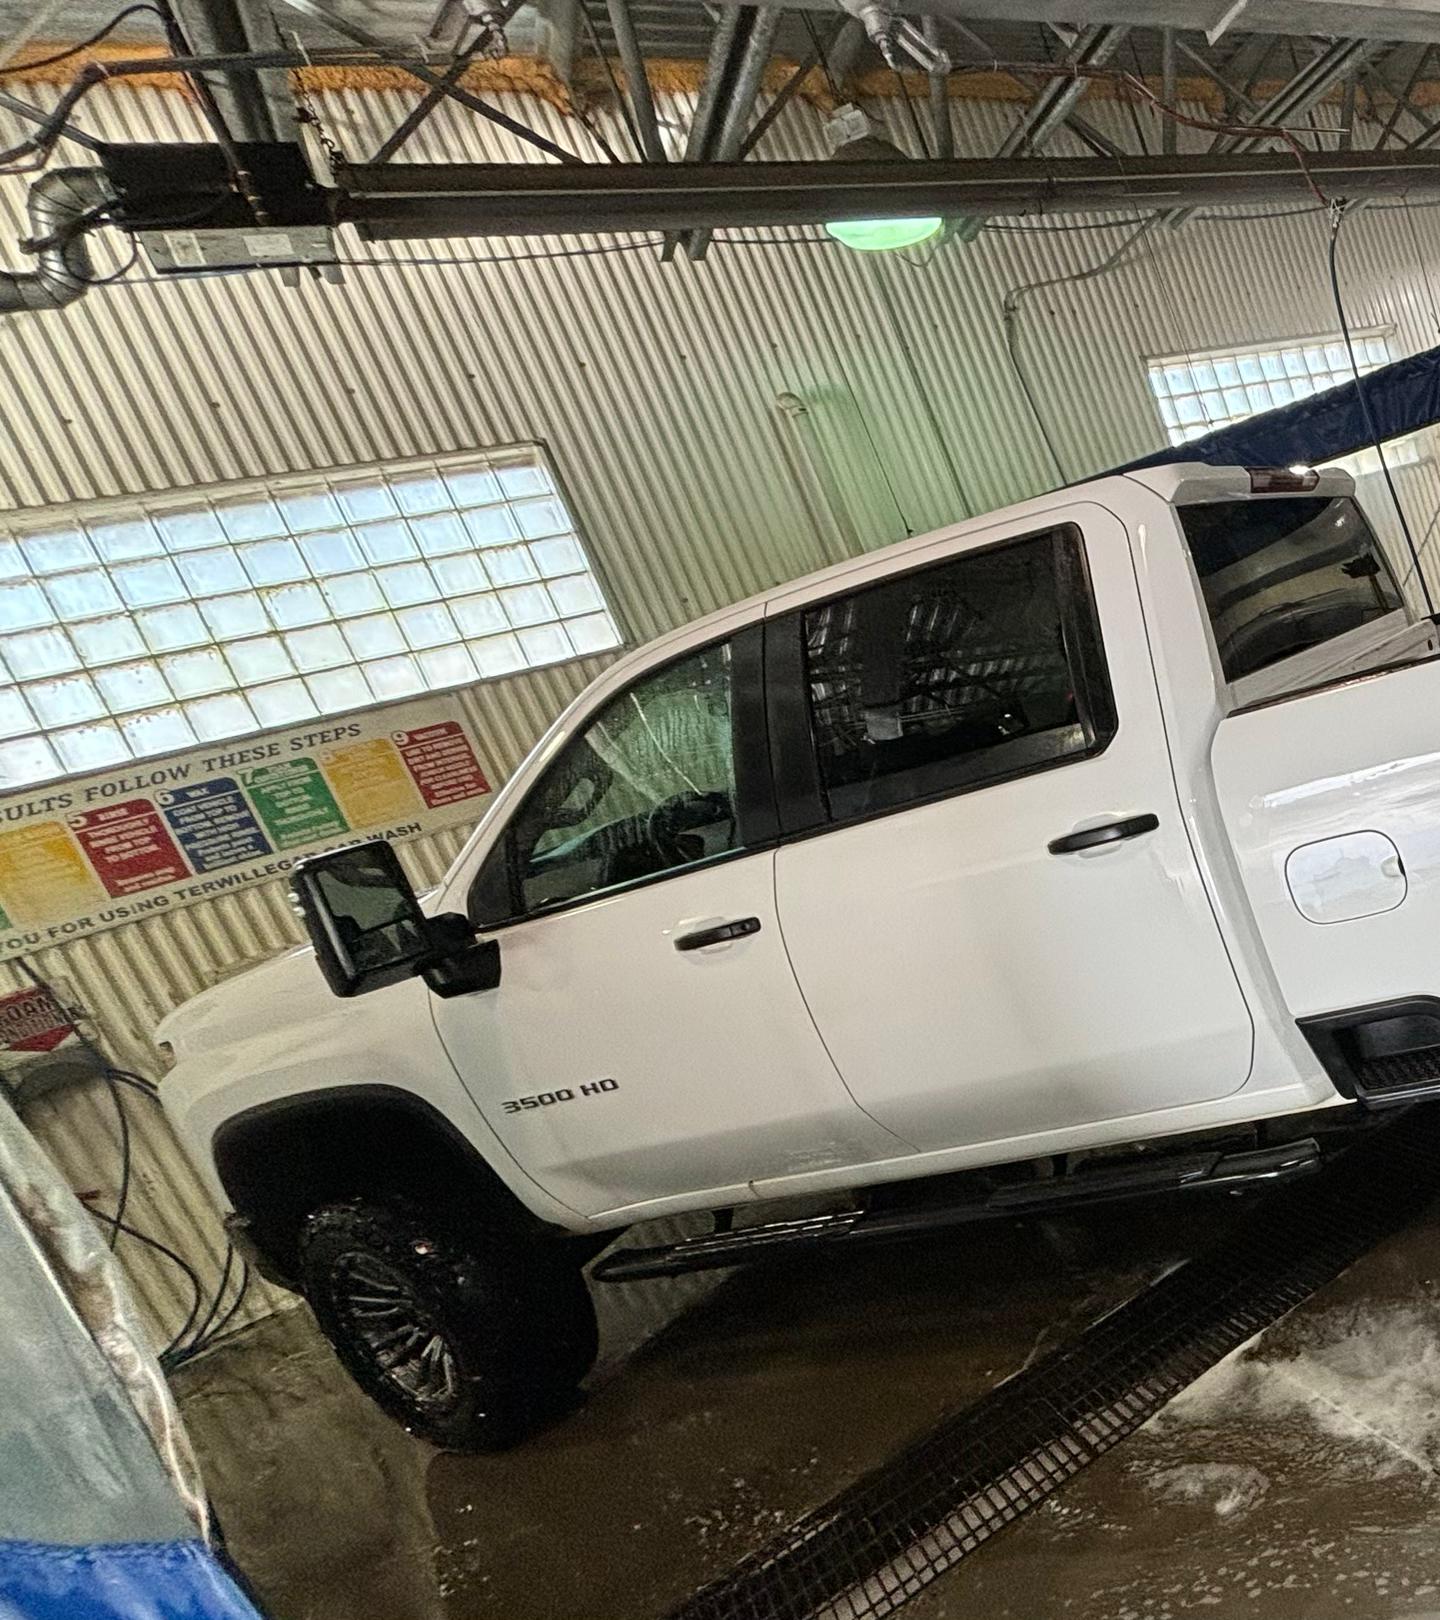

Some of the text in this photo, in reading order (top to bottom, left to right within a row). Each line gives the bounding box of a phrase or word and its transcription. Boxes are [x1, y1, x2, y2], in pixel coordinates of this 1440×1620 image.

[391, 730, 409, 746] 9
[85, 763, 192, 802] FOLLOW
[202, 743, 281, 772] THESE
[290, 723, 361, 751] STEPS
[236, 767, 254, 786] 7
[154, 788, 175, 806] 6
[65, 811, 88, 828] 5
[47, 917, 95, 938] FOR
[100, 896, 170, 922] USING
[366, 822, 422, 841] WASH
[501, 1078, 620, 1114] 3500 HD
